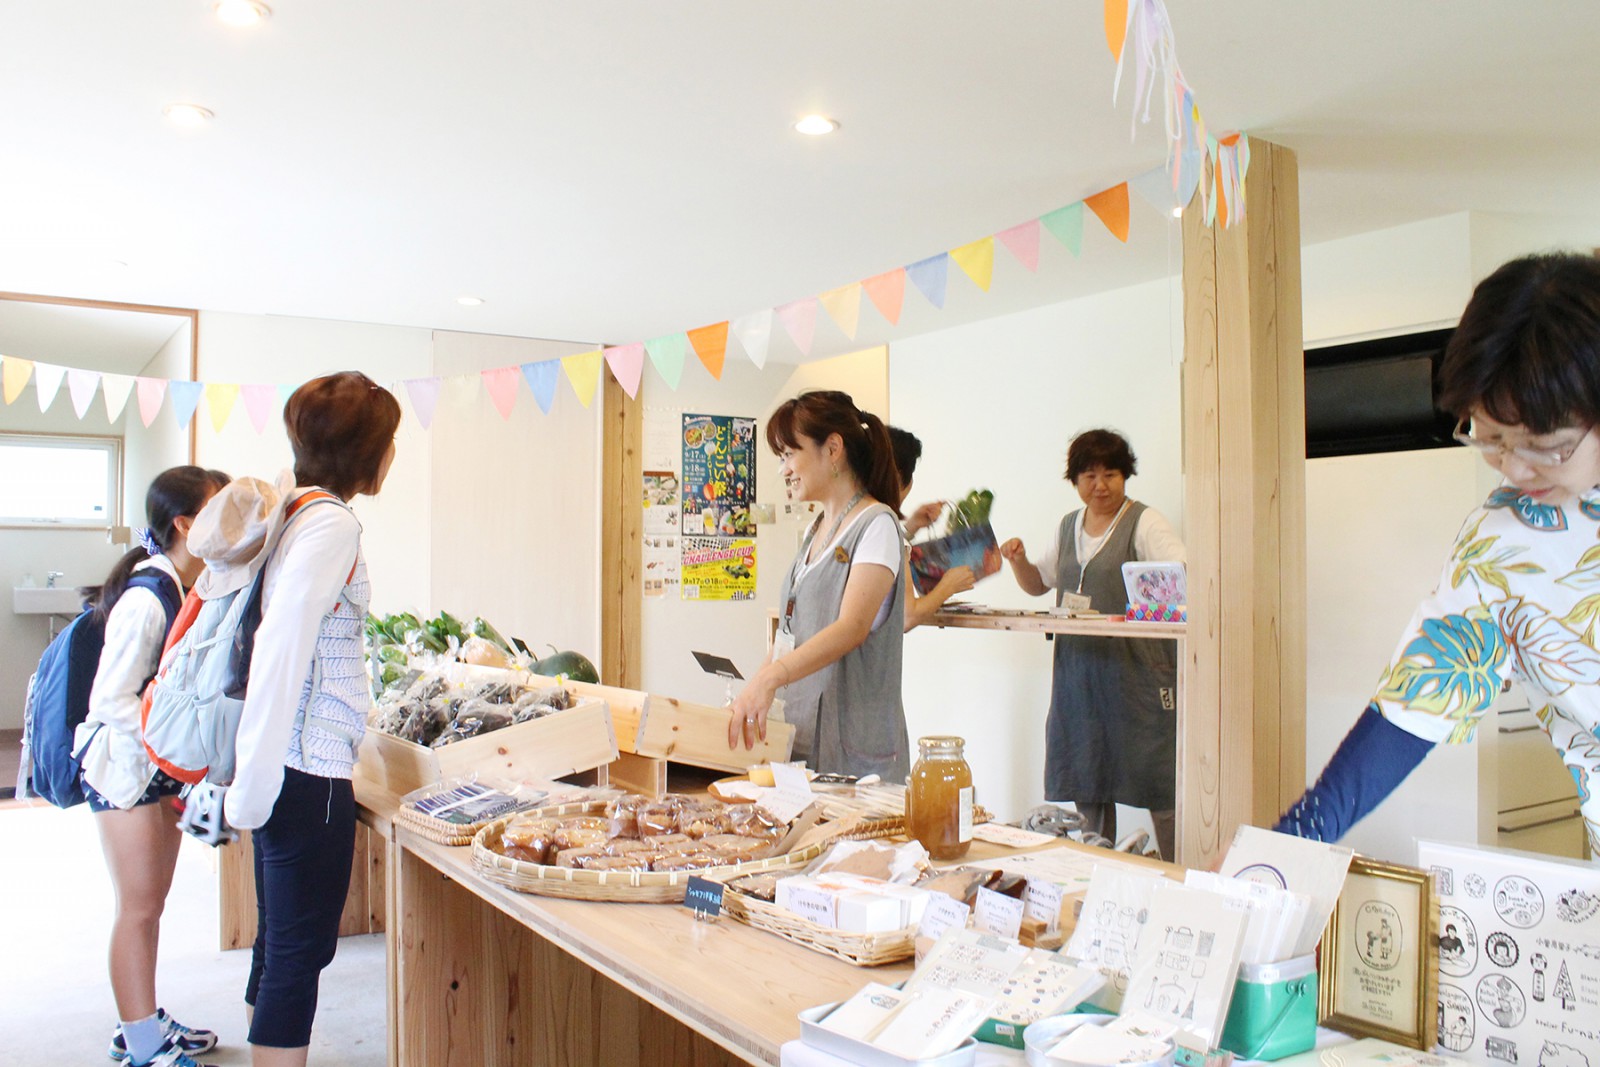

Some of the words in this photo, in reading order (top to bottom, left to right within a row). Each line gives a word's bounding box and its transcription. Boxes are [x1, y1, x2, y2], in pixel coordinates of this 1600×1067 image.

[714, 425, 727, 497] どんこい祭
[683, 549, 735, 566] CHALLENGE
[736, 545, 755, 557] CUP
